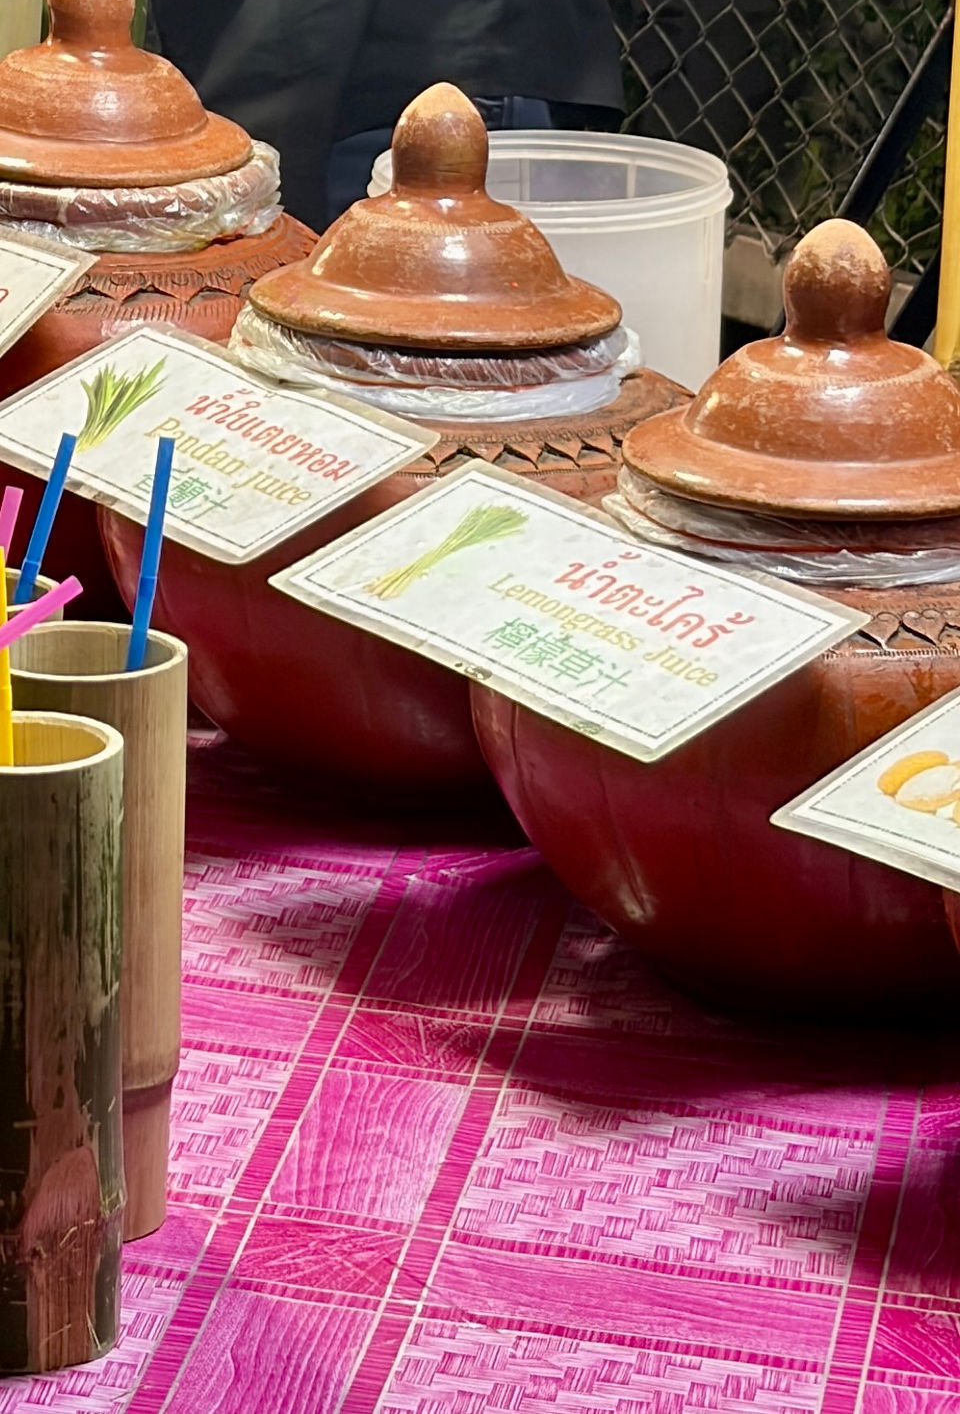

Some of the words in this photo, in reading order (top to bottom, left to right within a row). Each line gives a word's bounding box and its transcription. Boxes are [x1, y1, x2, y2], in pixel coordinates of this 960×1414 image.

[185, 388, 360, 481] น้ำใบเตยหอม
[488, 572, 643, 652] Lemongrass
[642, 645, 720, 688] Juice
[554, 551, 755, 648] น้ำตะไคร้
[482, 617, 632, 698] 檸檬草汁
